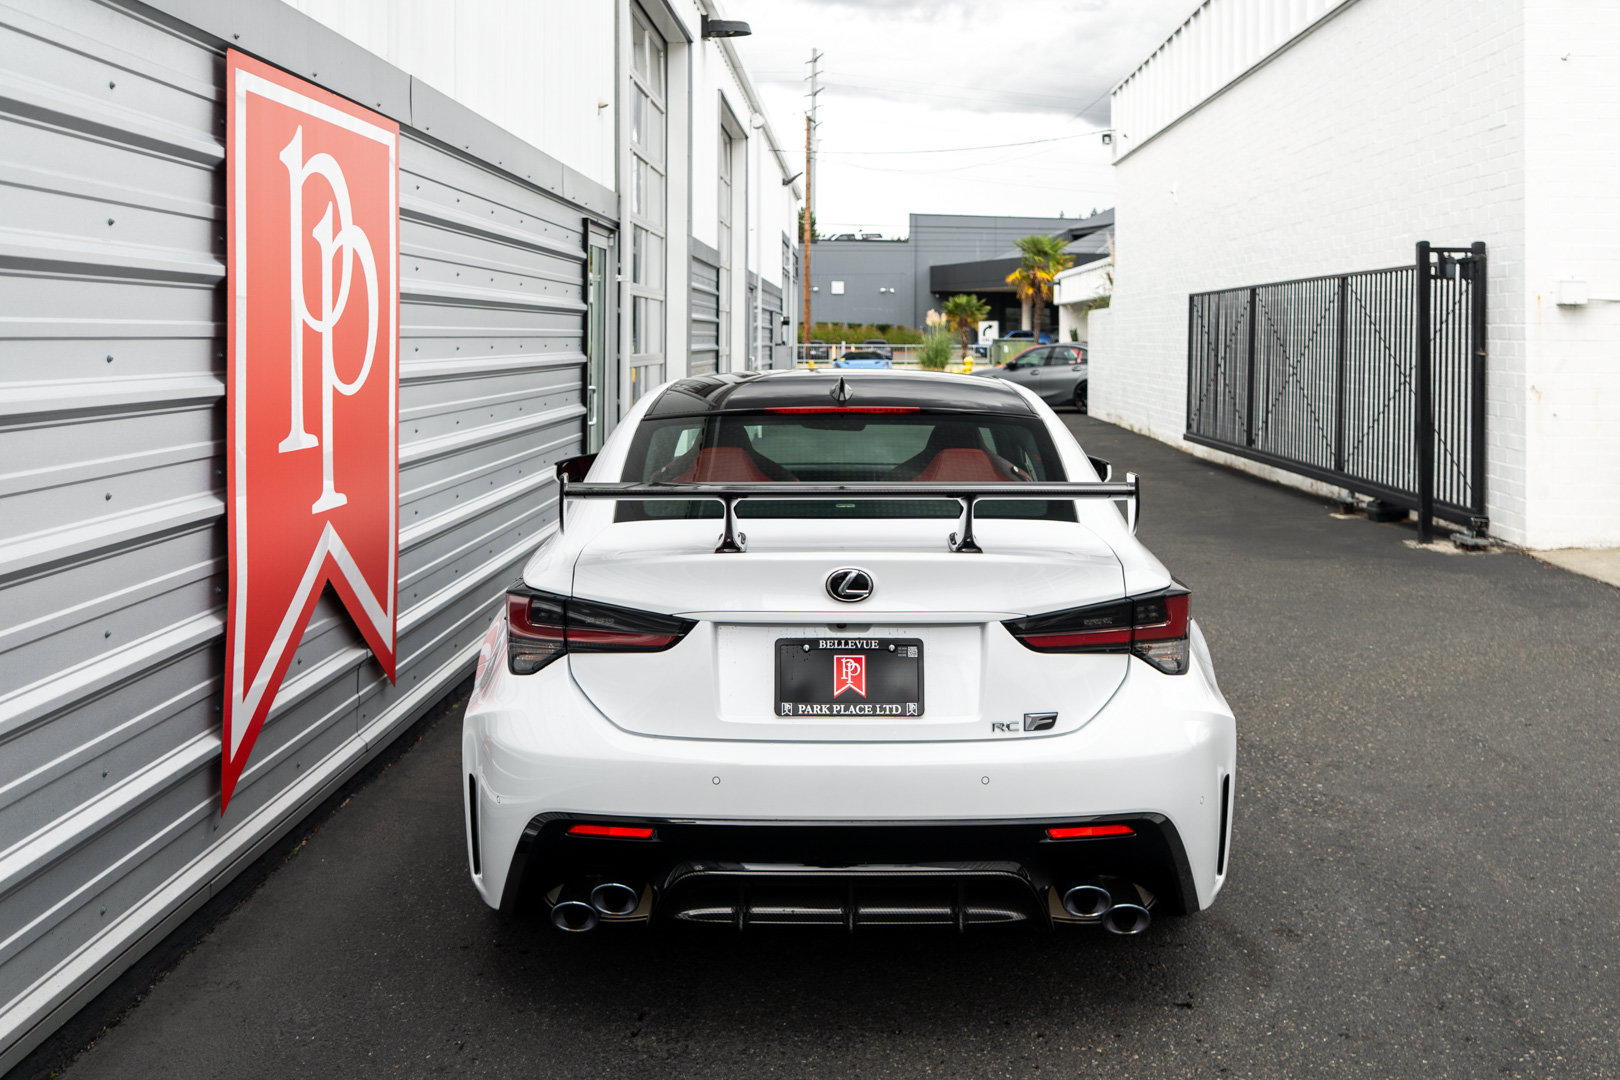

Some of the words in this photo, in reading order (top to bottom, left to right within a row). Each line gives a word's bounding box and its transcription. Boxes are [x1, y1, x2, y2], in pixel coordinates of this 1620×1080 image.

[818, 640, 880, 649] BELLEVUE
[798, 704, 831, 715] PARK
[832, 704, 873, 715] PLACE
[876, 704, 902, 715] LTD
[991, 722, 1020, 732] RC
